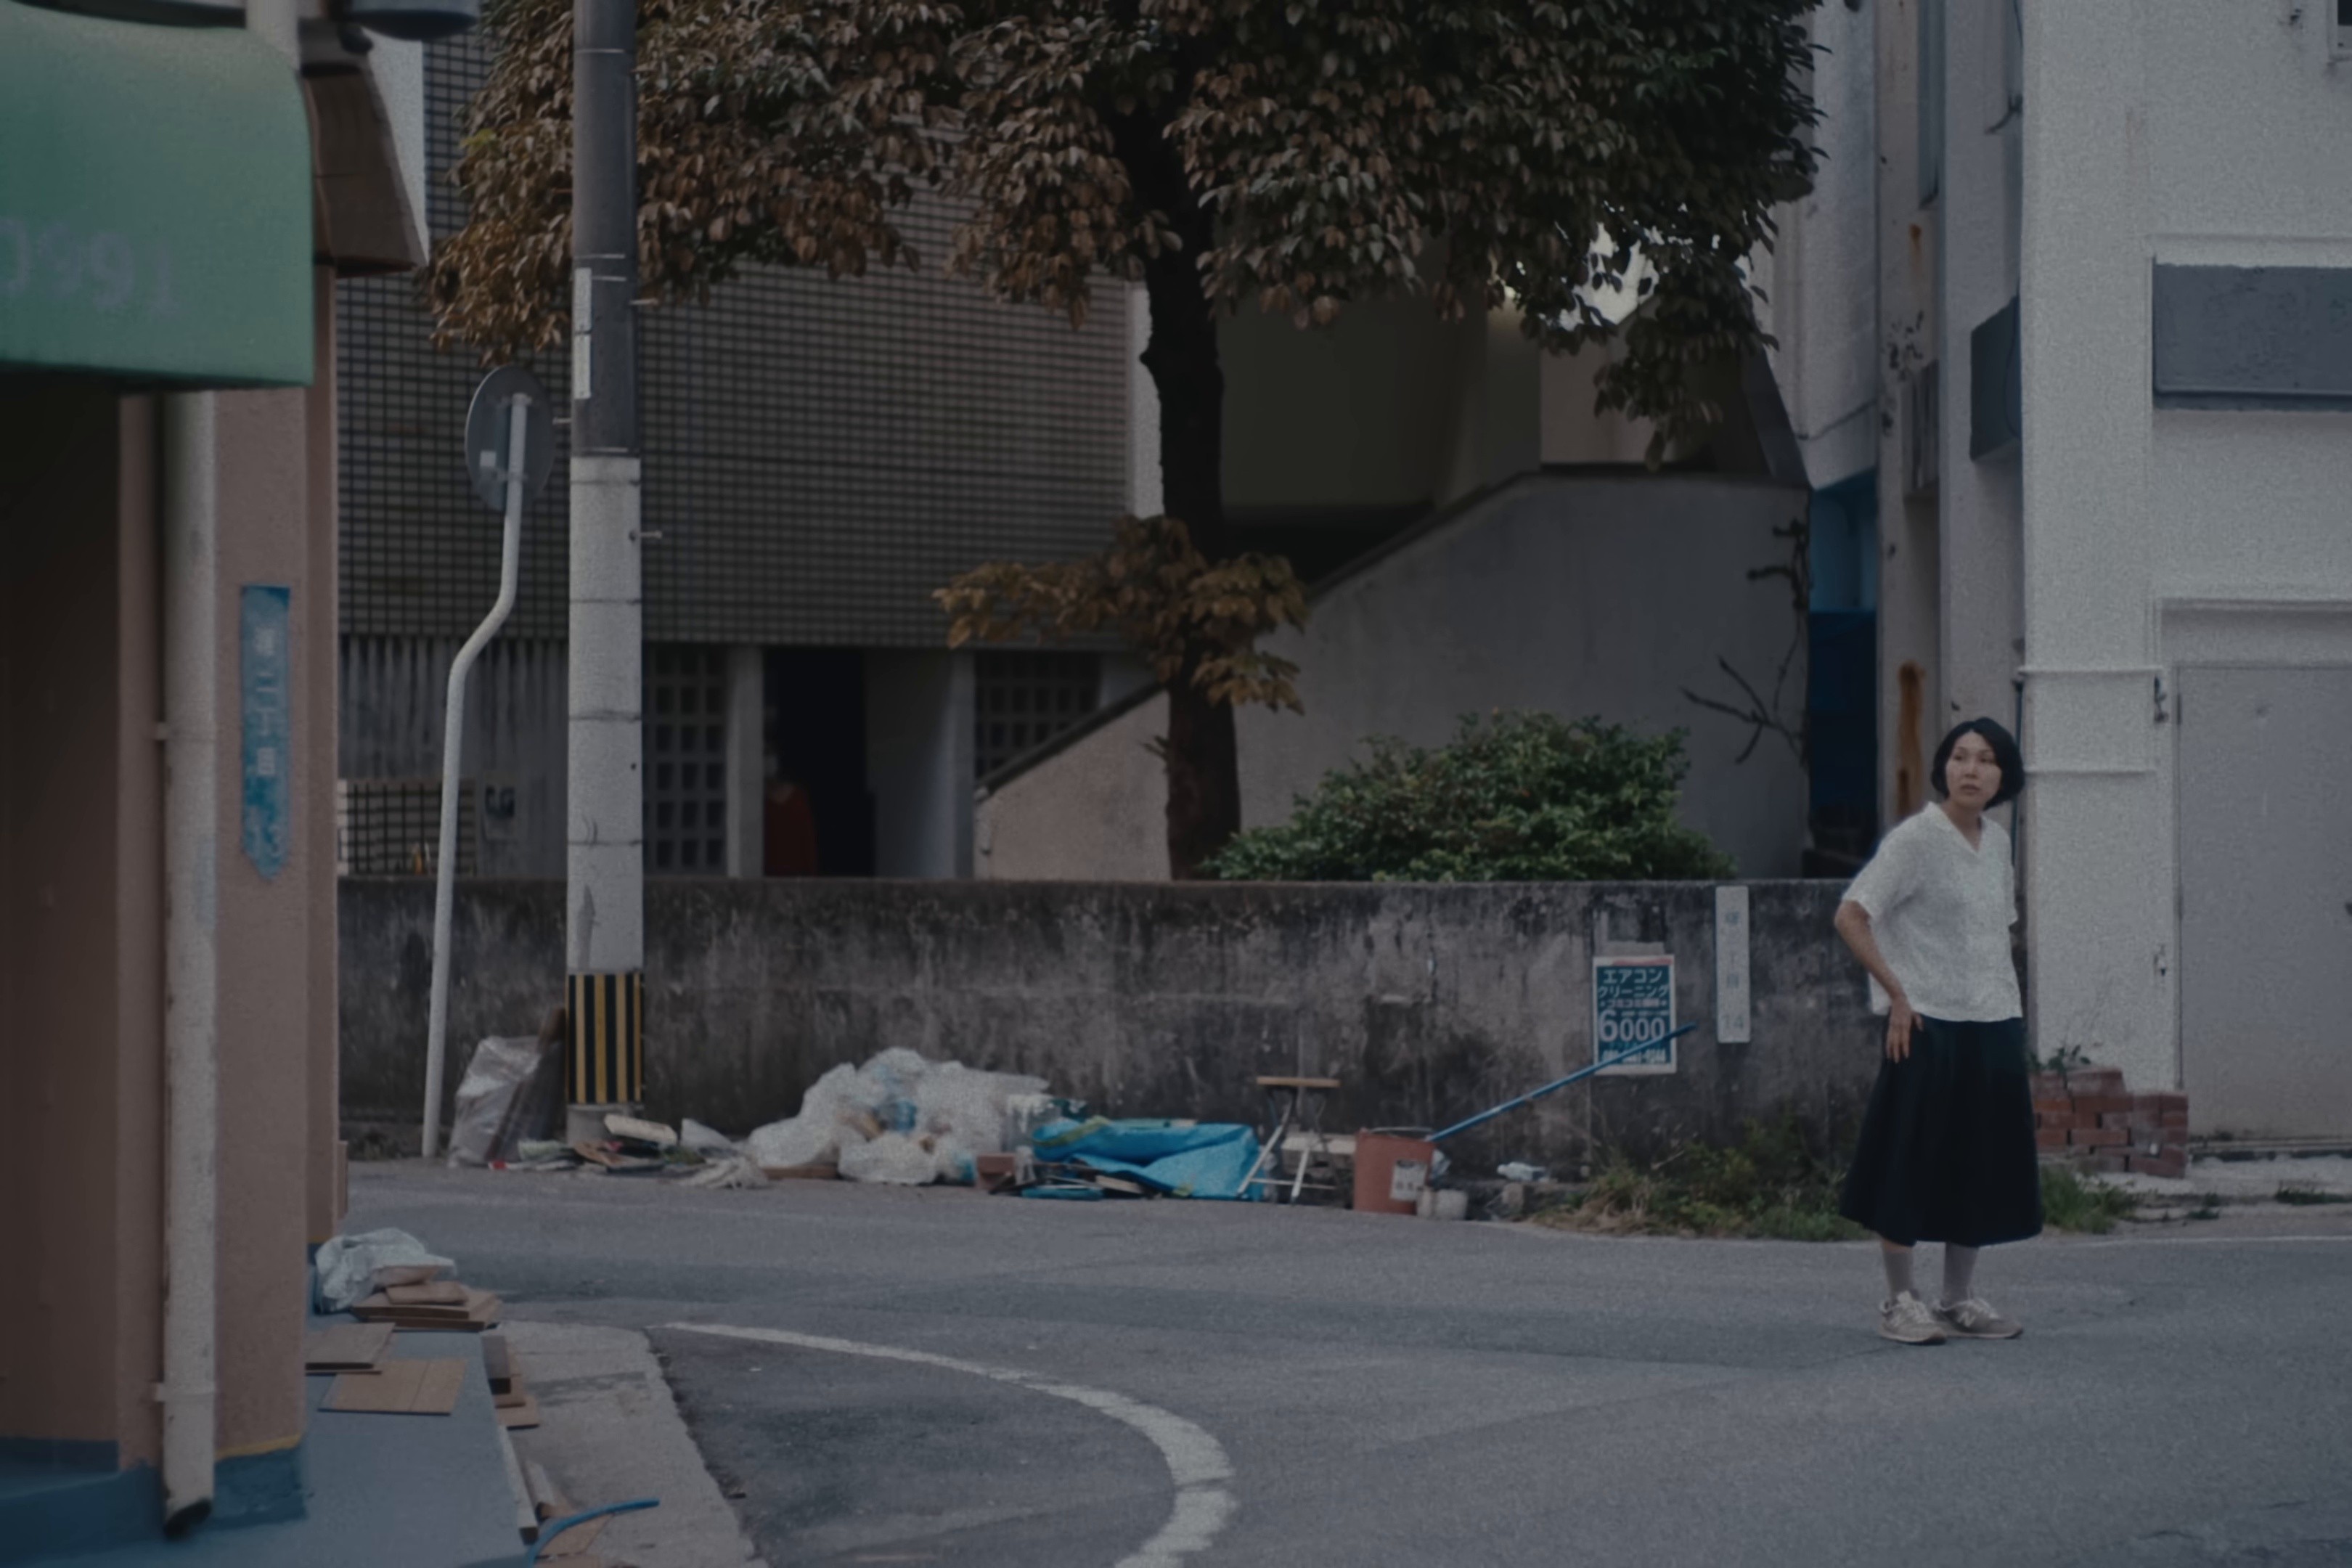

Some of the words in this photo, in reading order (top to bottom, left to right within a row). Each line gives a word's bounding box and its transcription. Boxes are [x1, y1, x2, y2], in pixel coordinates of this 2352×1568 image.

[1603, 968, 1663, 984] エアコン
[1598, 984, 1670, 998] クリーニング
[1599, 1009, 1666, 1042] 6000
